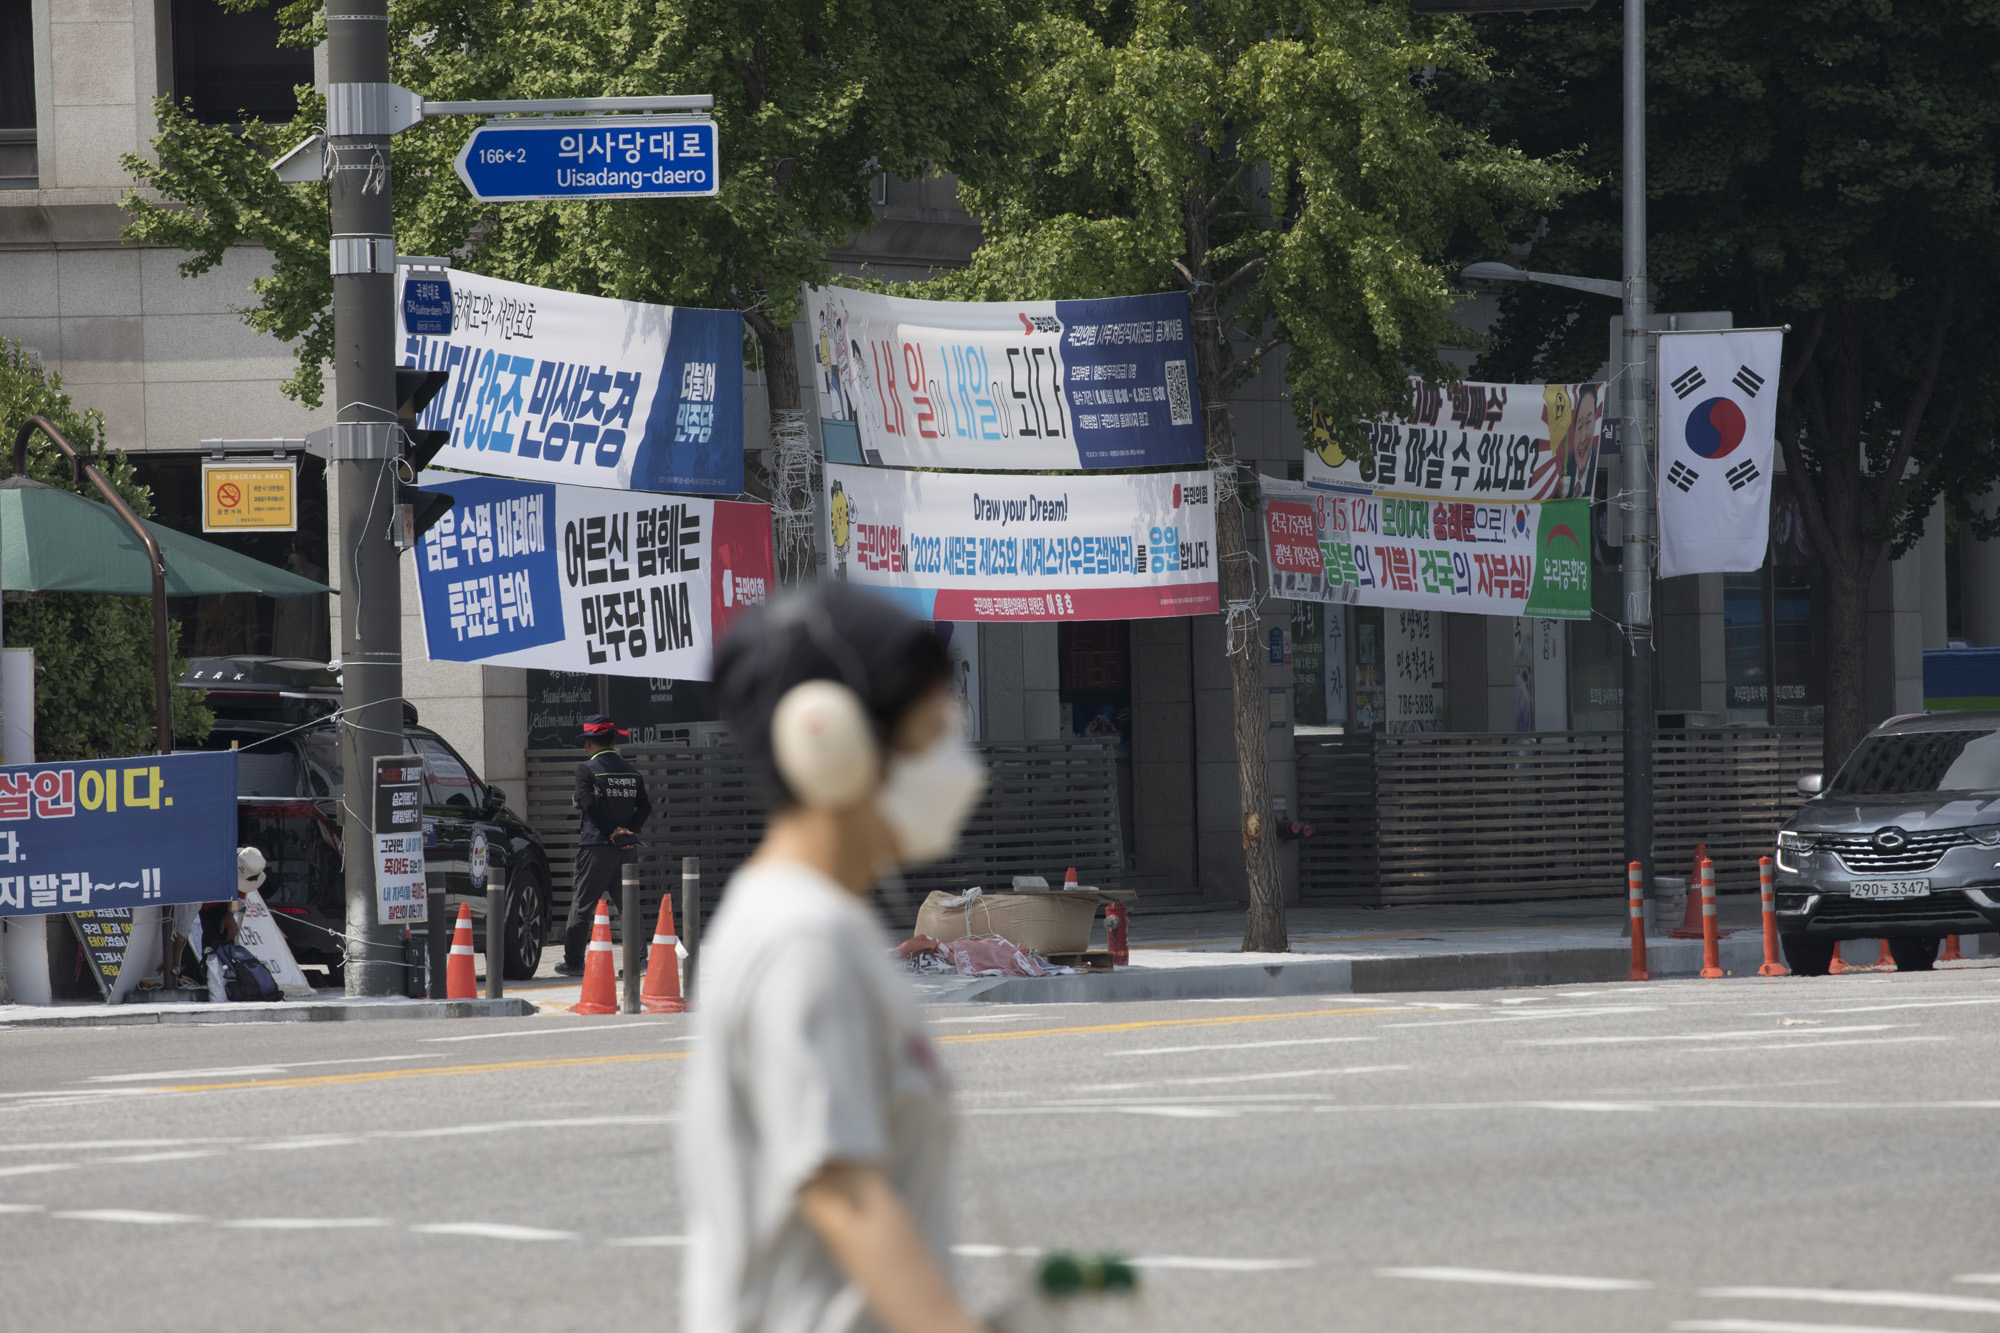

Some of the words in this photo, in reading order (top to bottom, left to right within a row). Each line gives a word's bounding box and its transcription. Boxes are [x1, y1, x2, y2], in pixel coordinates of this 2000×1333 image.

[557, 131, 706, 164] 의사당대로
[557, 167, 706, 190] Uisadang-daero
[416, 283, 440, 301] 국회대로
[406, 300, 416, 314] 754
[441, 301, 451, 314] 750
[1030, 316, 1060, 333] 국민의힘
[1068, 325, 1098, 347] 국민의힘
[1156, 319, 1184, 342] 공개채용
[680, 361, 717, 402] 더불어
[1071, 365, 1089, 381] 모집부문
[1006, 346, 1067, 440] 되다
[1072, 389, 1094, 405] 접수기간
[463, 348, 535, 454] 35조
[517, 359, 642, 469] 민생추경
[1079, 415, 1098, 429] 지원방법
[1101, 413, 1120, 429] 국민의힘
[1119, 412, 1140, 428] 홈페이지
[1139, 412, 1149, 426] 참고
[673, 403, 715, 443] 민주당
[1404, 427, 1448, 490] 마실
[1451, 431, 1471, 492] 수
[1472, 432, 1540, 493] 있나요?
[1183, 485, 1209, 506] 국민의힘
[973, 492, 1001, 522] Draw
[1001, 498, 1027, 527] your
[1029, 493, 1069, 522] Dream!
[1351, 498, 1378, 534] 12시
[1433, 501, 1508, 544] 숭례문으로!
[425, 508, 459, 573] 남은
[460, 503, 494, 566] 수명
[495, 493, 546, 559] 비례해
[1271, 511, 1287, 534] 건국
[1288, 514, 1313, 536] 75주년
[564, 511, 630, 588] 어르신
[636, 503, 701, 580] 폄훼는
[857, 523, 909, 574] 국민의힘이
[943, 535, 977, 576] 새만금
[978, 536, 1018, 577] 제25회
[1149, 526, 1209, 575] 응원합니다
[1274, 544, 1293, 566] 광복
[1293, 546, 1321, 568] 78주년
[1319, 539, 1376, 590] 광복의
[1374, 546, 1419, 593] 기쁨!
[1418, 549, 1472, 597] 건국의
[1474, 552, 1532, 600] 자부심!
[1543, 557, 1588, 592] 우리공화당
[735, 575, 766, 608] 국민의힘
[448, 575, 500, 642] 투표권
[499, 568, 536, 634] 부여
[973, 597, 994, 616] 국민의힘
[1028, 597, 1045, 616] 위원장
[581, 587, 648, 666] 민주당
[650, 581, 694, 654] DNA
[1272, 645, 1282, 660] 750
[1398, 693, 1434, 716] 786-5898
[1590, 688, 1602, 705] 토요일
[0, 766, 173, 821] 살인이다.
[380, 838, 405, 854] 그러면,
[384, 857, 409, 876] 죽여도
[383, 886, 391, 902] 내
[392, 886, 411, 902] 자식을
[1854, 883, 1889, 897] 290누
[1891, 882, 1924, 895] 3347
[82, 922, 102, 934] 우리
[100, 923, 121, 935] 딸과
[94, 952, 123, 964] 그래서
